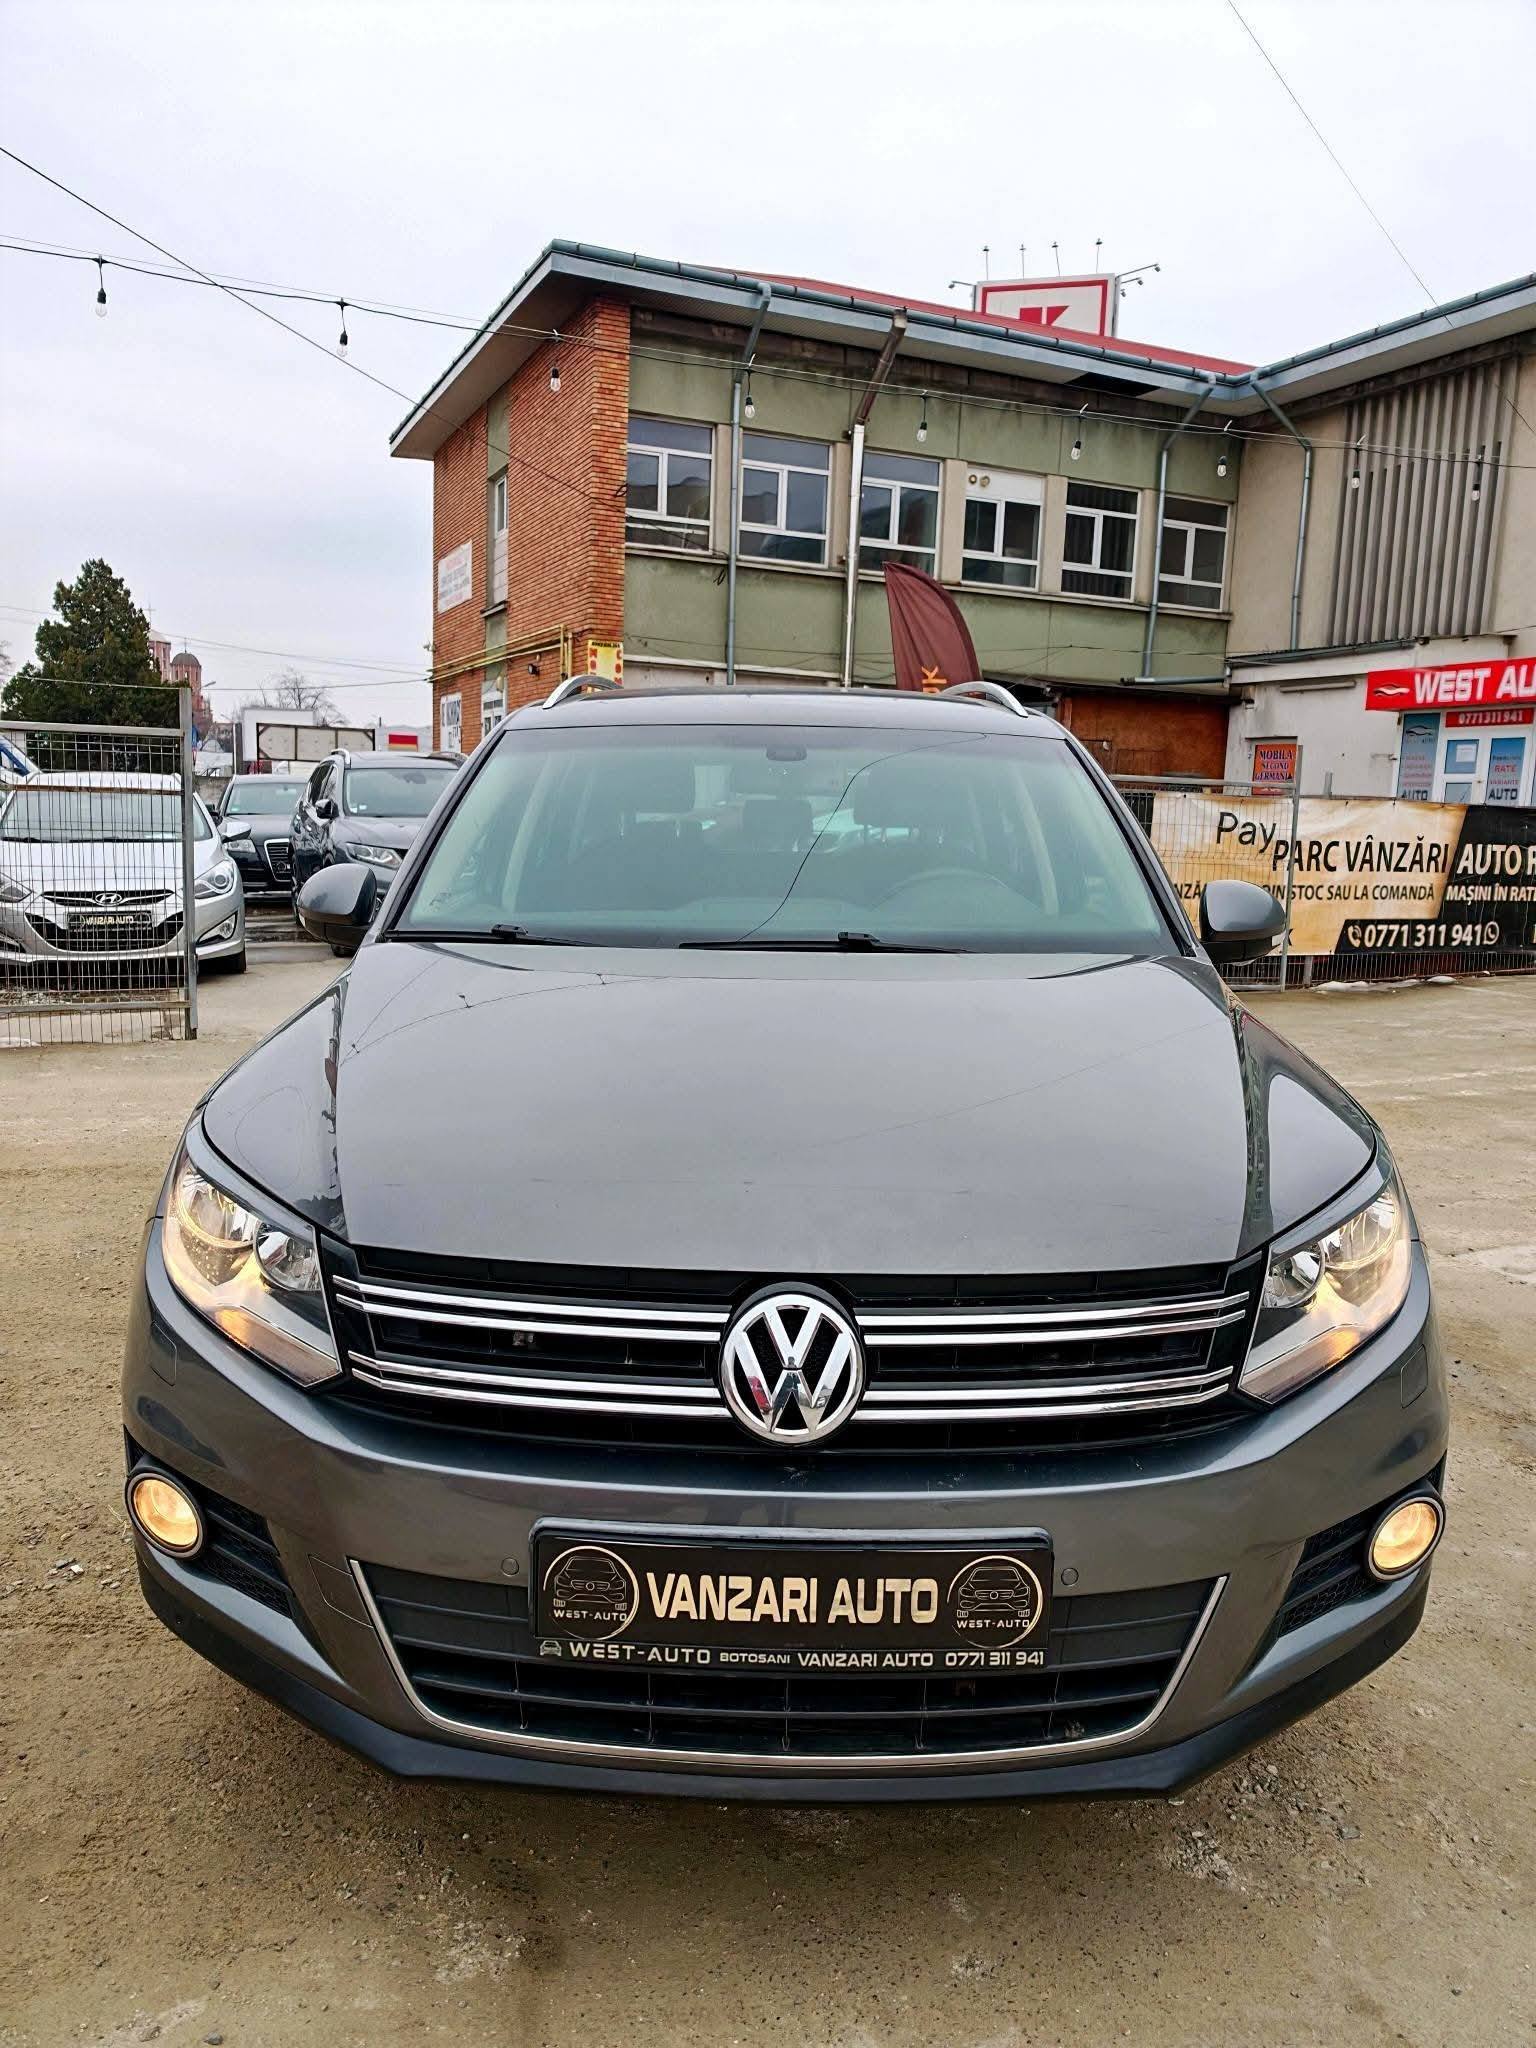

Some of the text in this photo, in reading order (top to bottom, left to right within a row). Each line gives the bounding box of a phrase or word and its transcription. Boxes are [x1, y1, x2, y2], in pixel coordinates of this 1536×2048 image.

[1414, 667, 1492, 704] WEST
[1401, 790, 1428, 801] AUTO
[1488, 788, 1518, 800] AUTO
[1216, 811, 1277, 853] Pay
[1272, 834, 1449, 873] PARC VÂNZĂRI
[1456, 843, 1522, 876] AUTO
[1291, 884, 1324, 900] STOC
[1326, 884, 1350, 900] SAU
[1353, 885, 1369, 900] LA
[1493, 882, 1508, 902] ÎN
[1364, 923, 1482, 947] 0771 311 941
[646, 1572, 939, 1624] VANZARI AUTO
[553, 1609, 628, 1622] WEST-AUTO
[956, 1618, 1030, 1628] WEST-AUTO
[569, 1641, 1044, 1667] WEST-AUTO BOTOSANI VANZARI AUTO 0771 311 941
